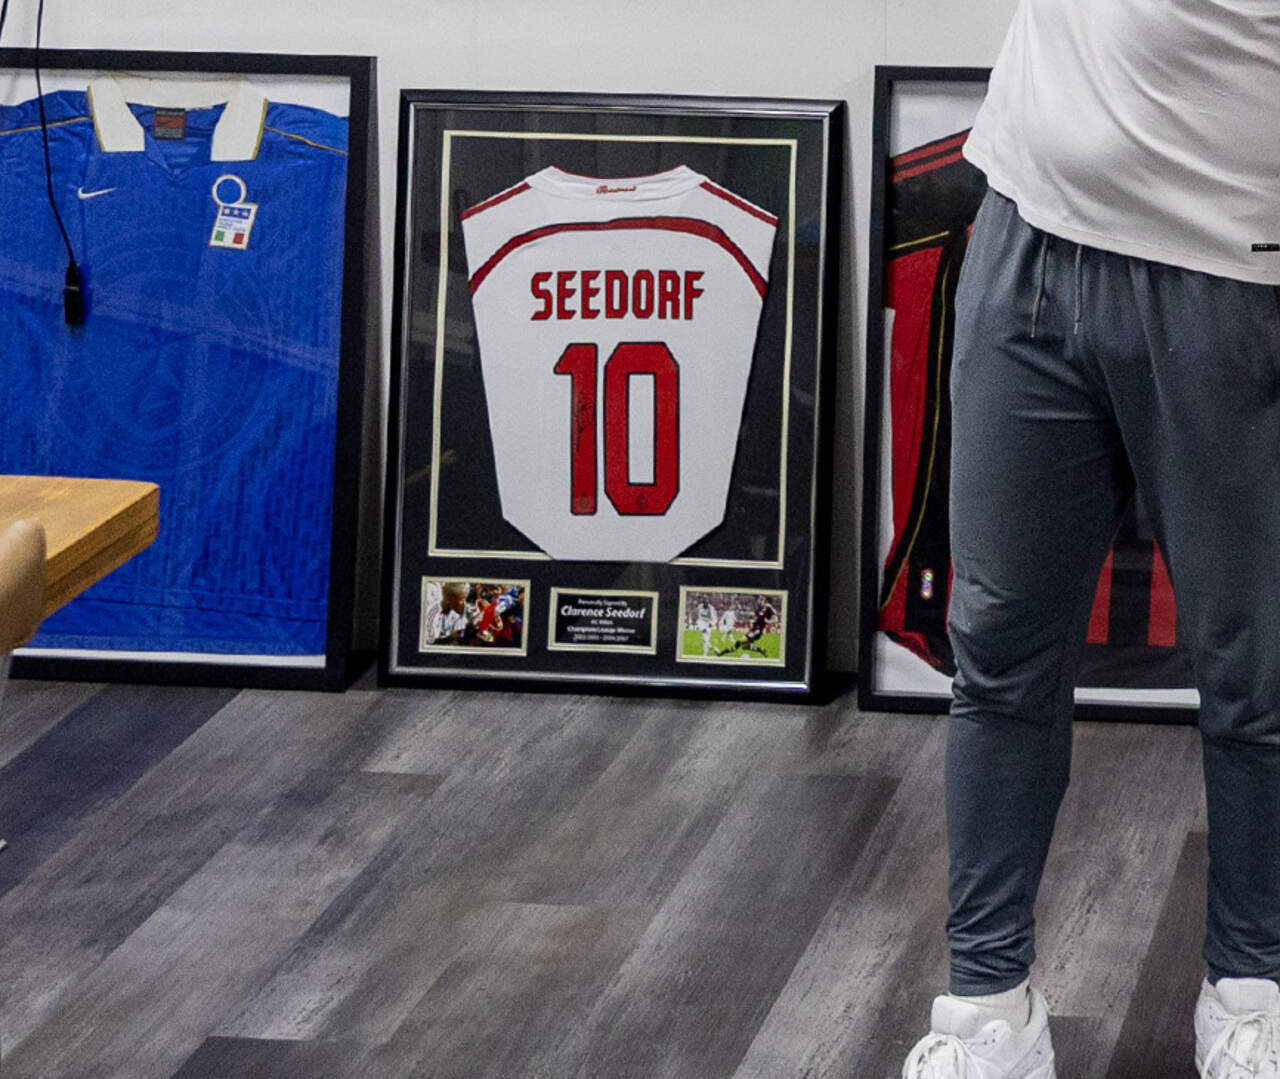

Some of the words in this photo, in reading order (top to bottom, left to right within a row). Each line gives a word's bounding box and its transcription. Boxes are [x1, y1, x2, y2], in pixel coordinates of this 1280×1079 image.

[530, 270, 705, 321] SEEDORF
[553, 341, 681, 517] 10
[561, 605, 603, 617] Clarence
[606, 607, 646, 619] Seedorf
